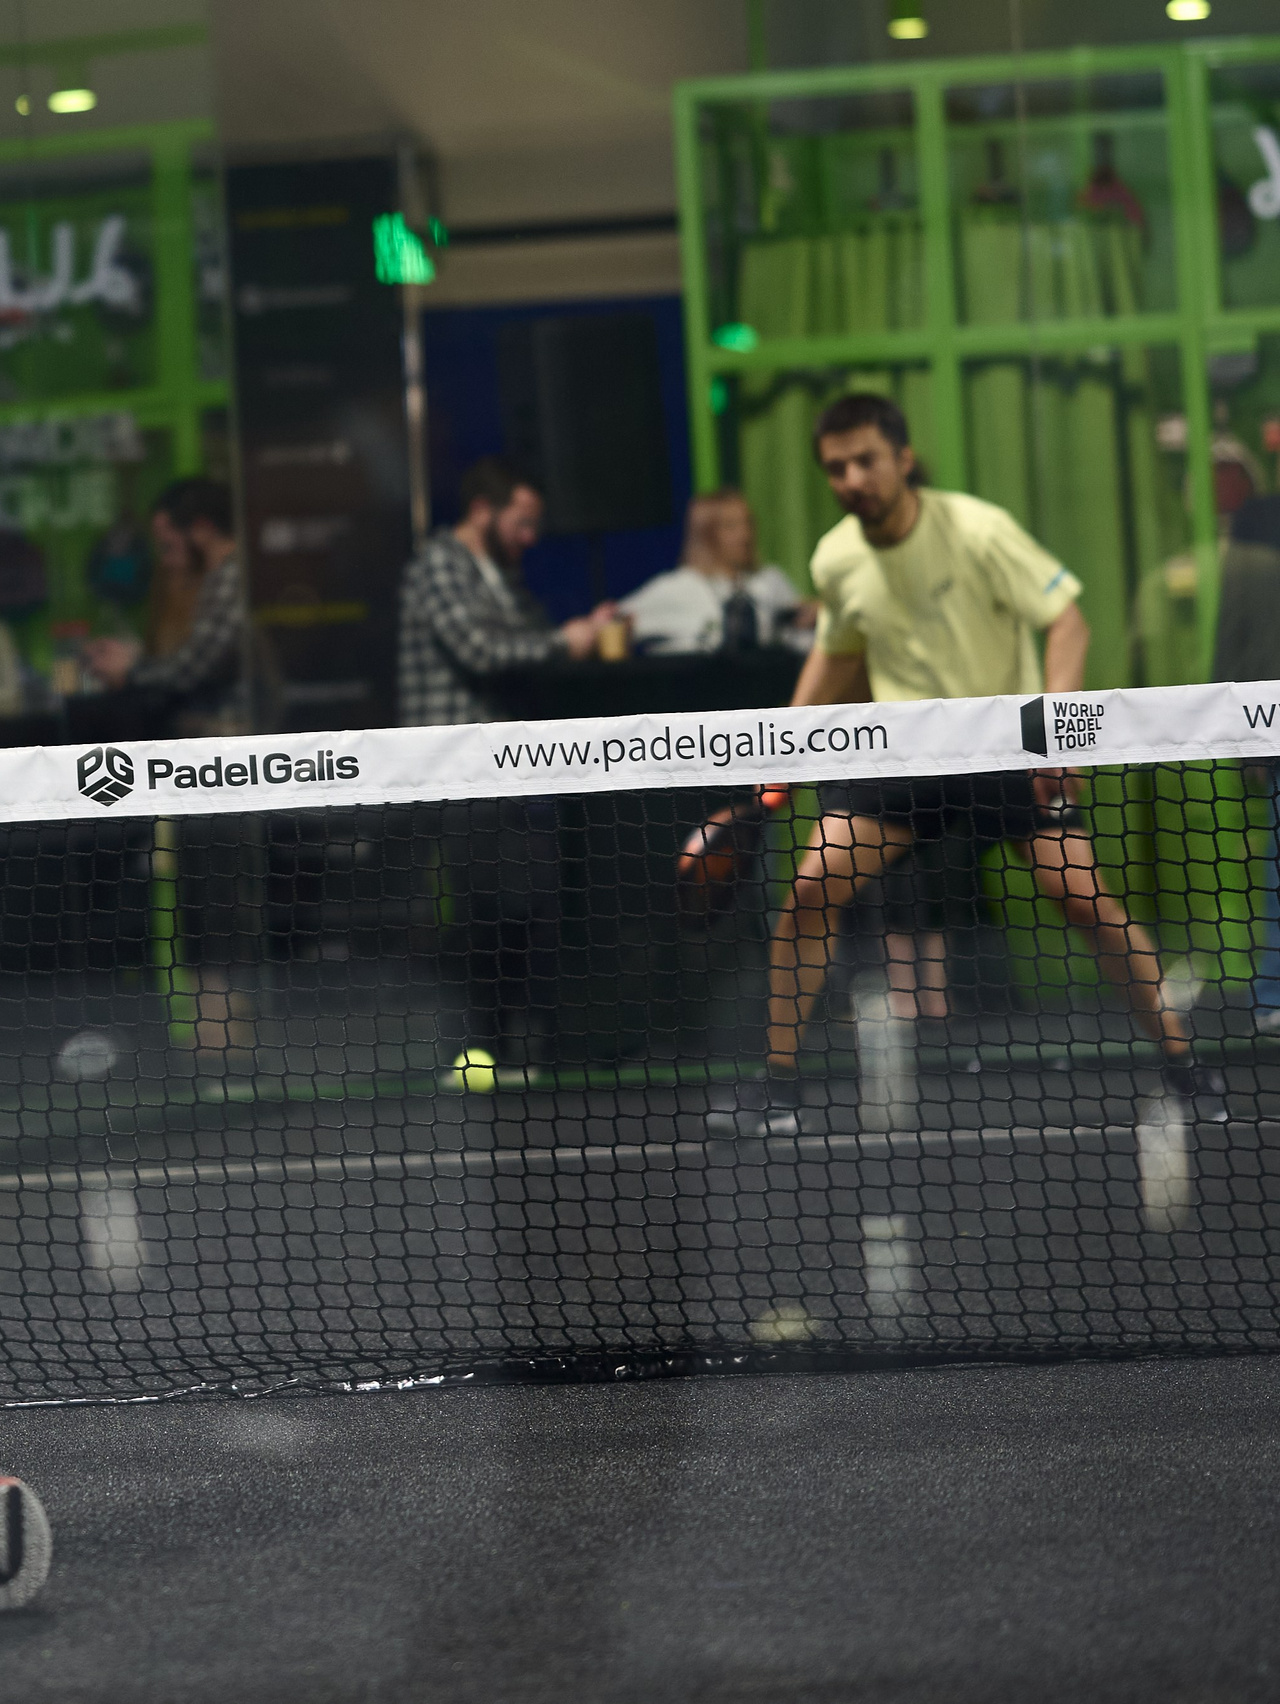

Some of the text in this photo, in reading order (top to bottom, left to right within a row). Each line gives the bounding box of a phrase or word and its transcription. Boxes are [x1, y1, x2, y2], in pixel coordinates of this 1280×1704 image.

[1053, 701, 1105, 718] WORLD
[1054, 718, 1103, 735] PADEL
[493, 721, 889, 772] www.padelgalis.com
[1054, 732, 1097, 751] TOUR
